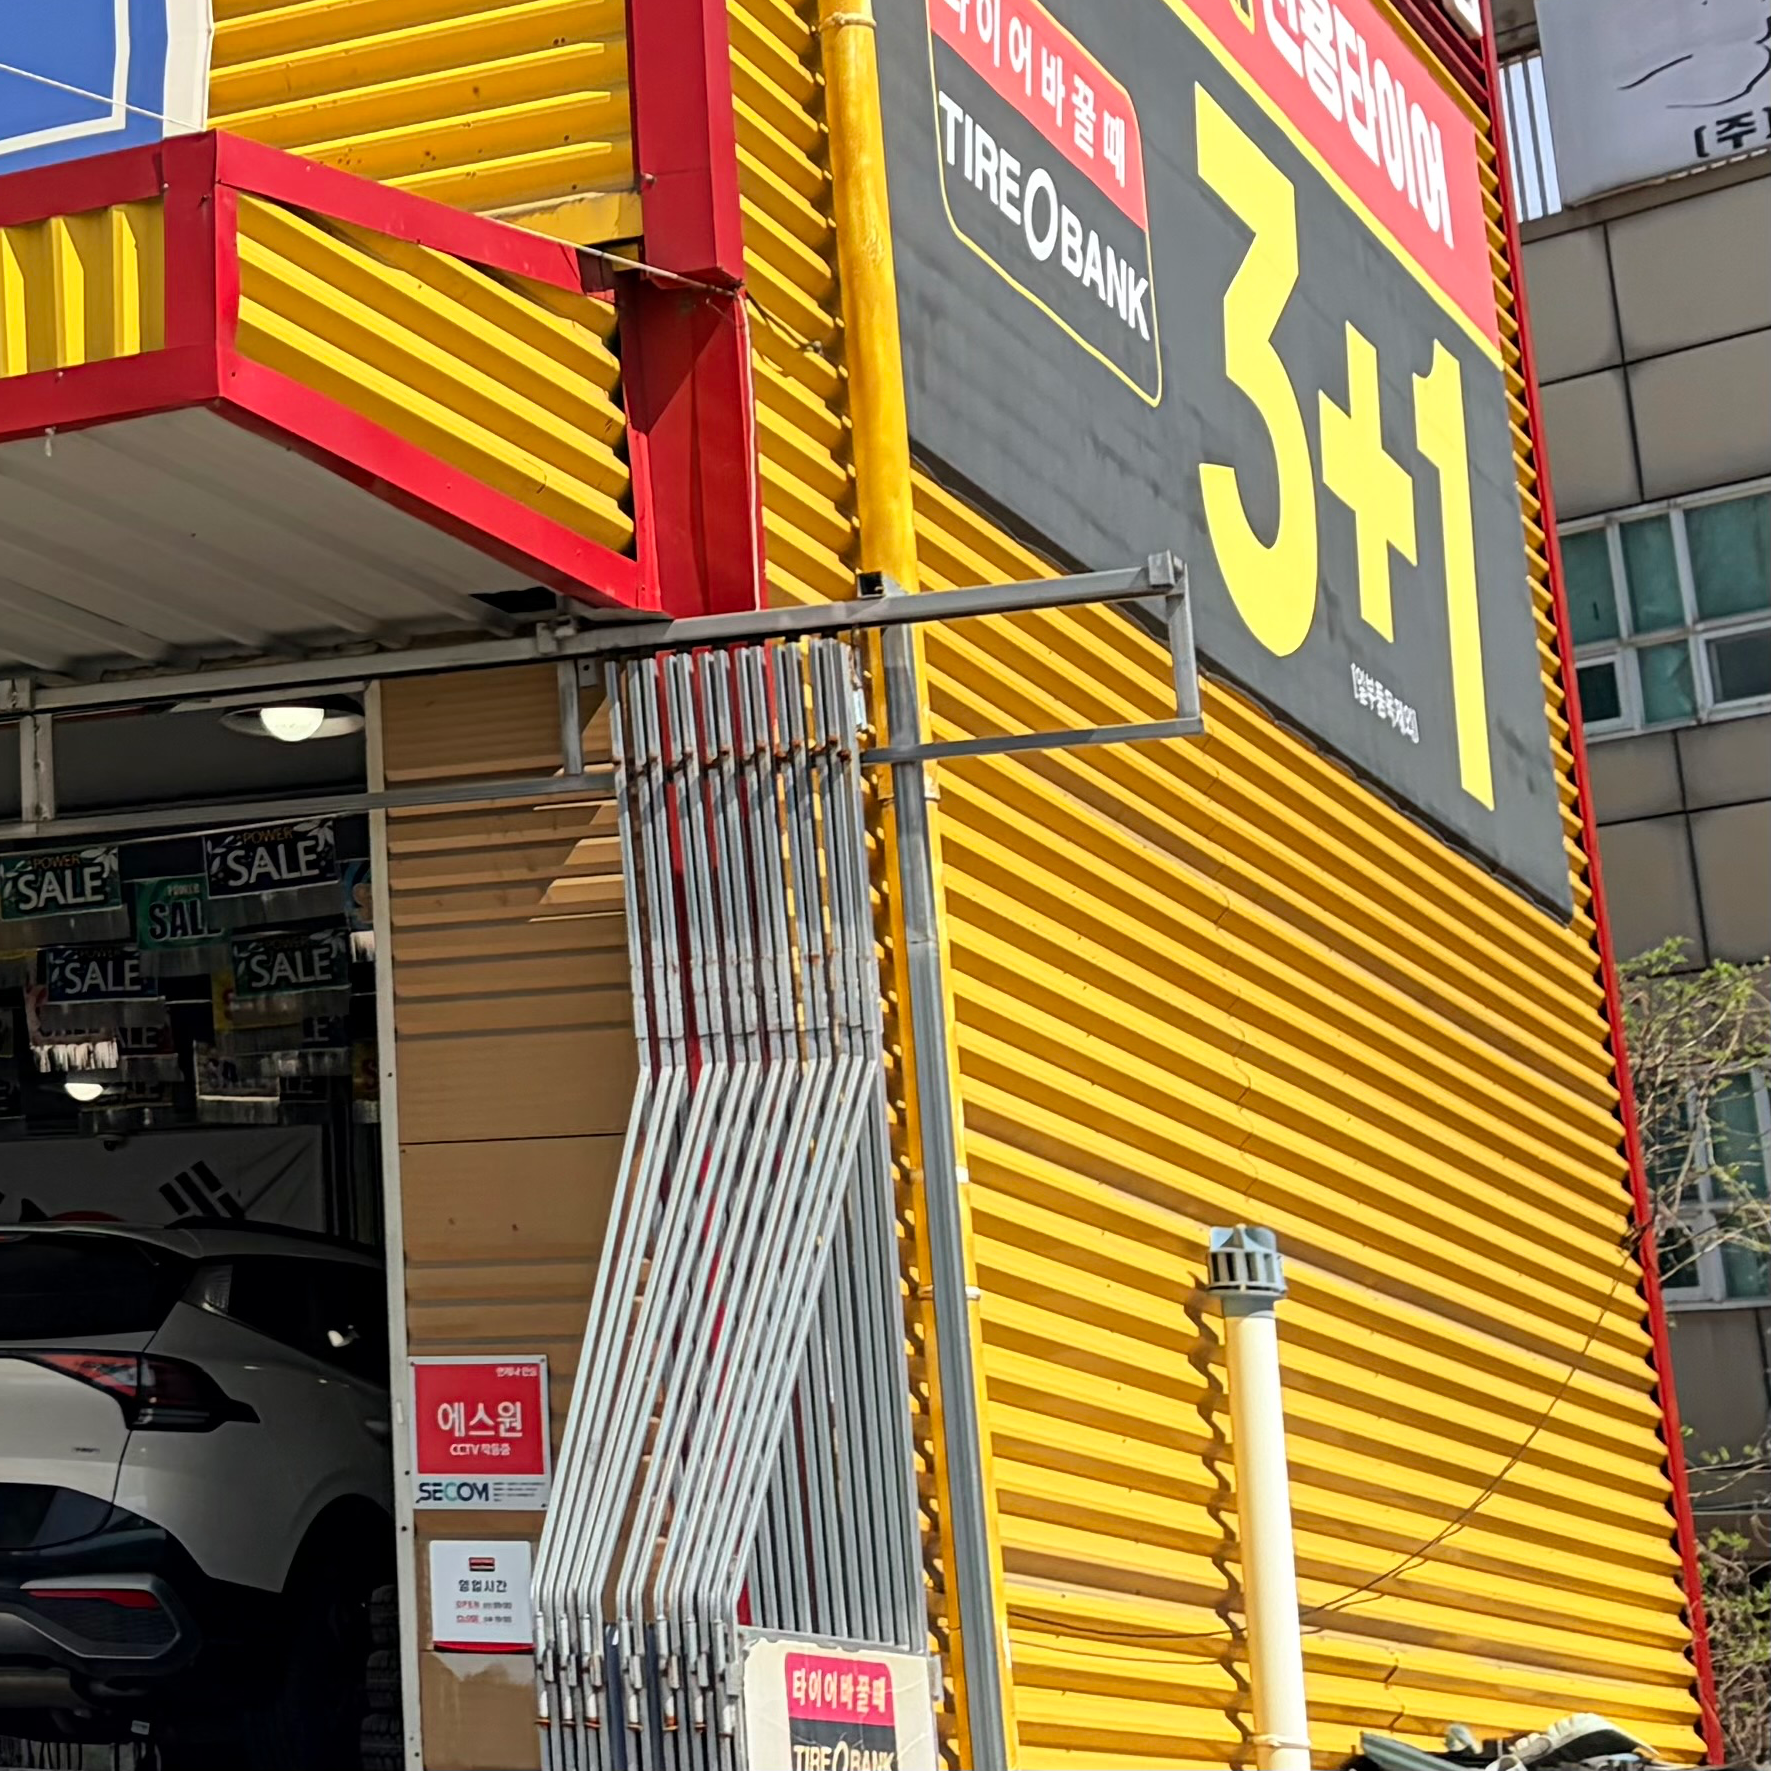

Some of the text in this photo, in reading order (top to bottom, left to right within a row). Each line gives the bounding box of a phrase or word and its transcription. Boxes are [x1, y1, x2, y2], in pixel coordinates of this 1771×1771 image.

[1194, 79, 1496, 813] 3+1
[227, 839, 320, 887] SALE
[18, 866, 105, 911] SALE
[64, 958, 142, 995] SALE
[250, 948, 332, 987] SALE
[437, 1401, 523, 1438] 에스원
[450, 1443, 480, 1456] CCTV
[415, 1482, 490, 1503] SECOM
